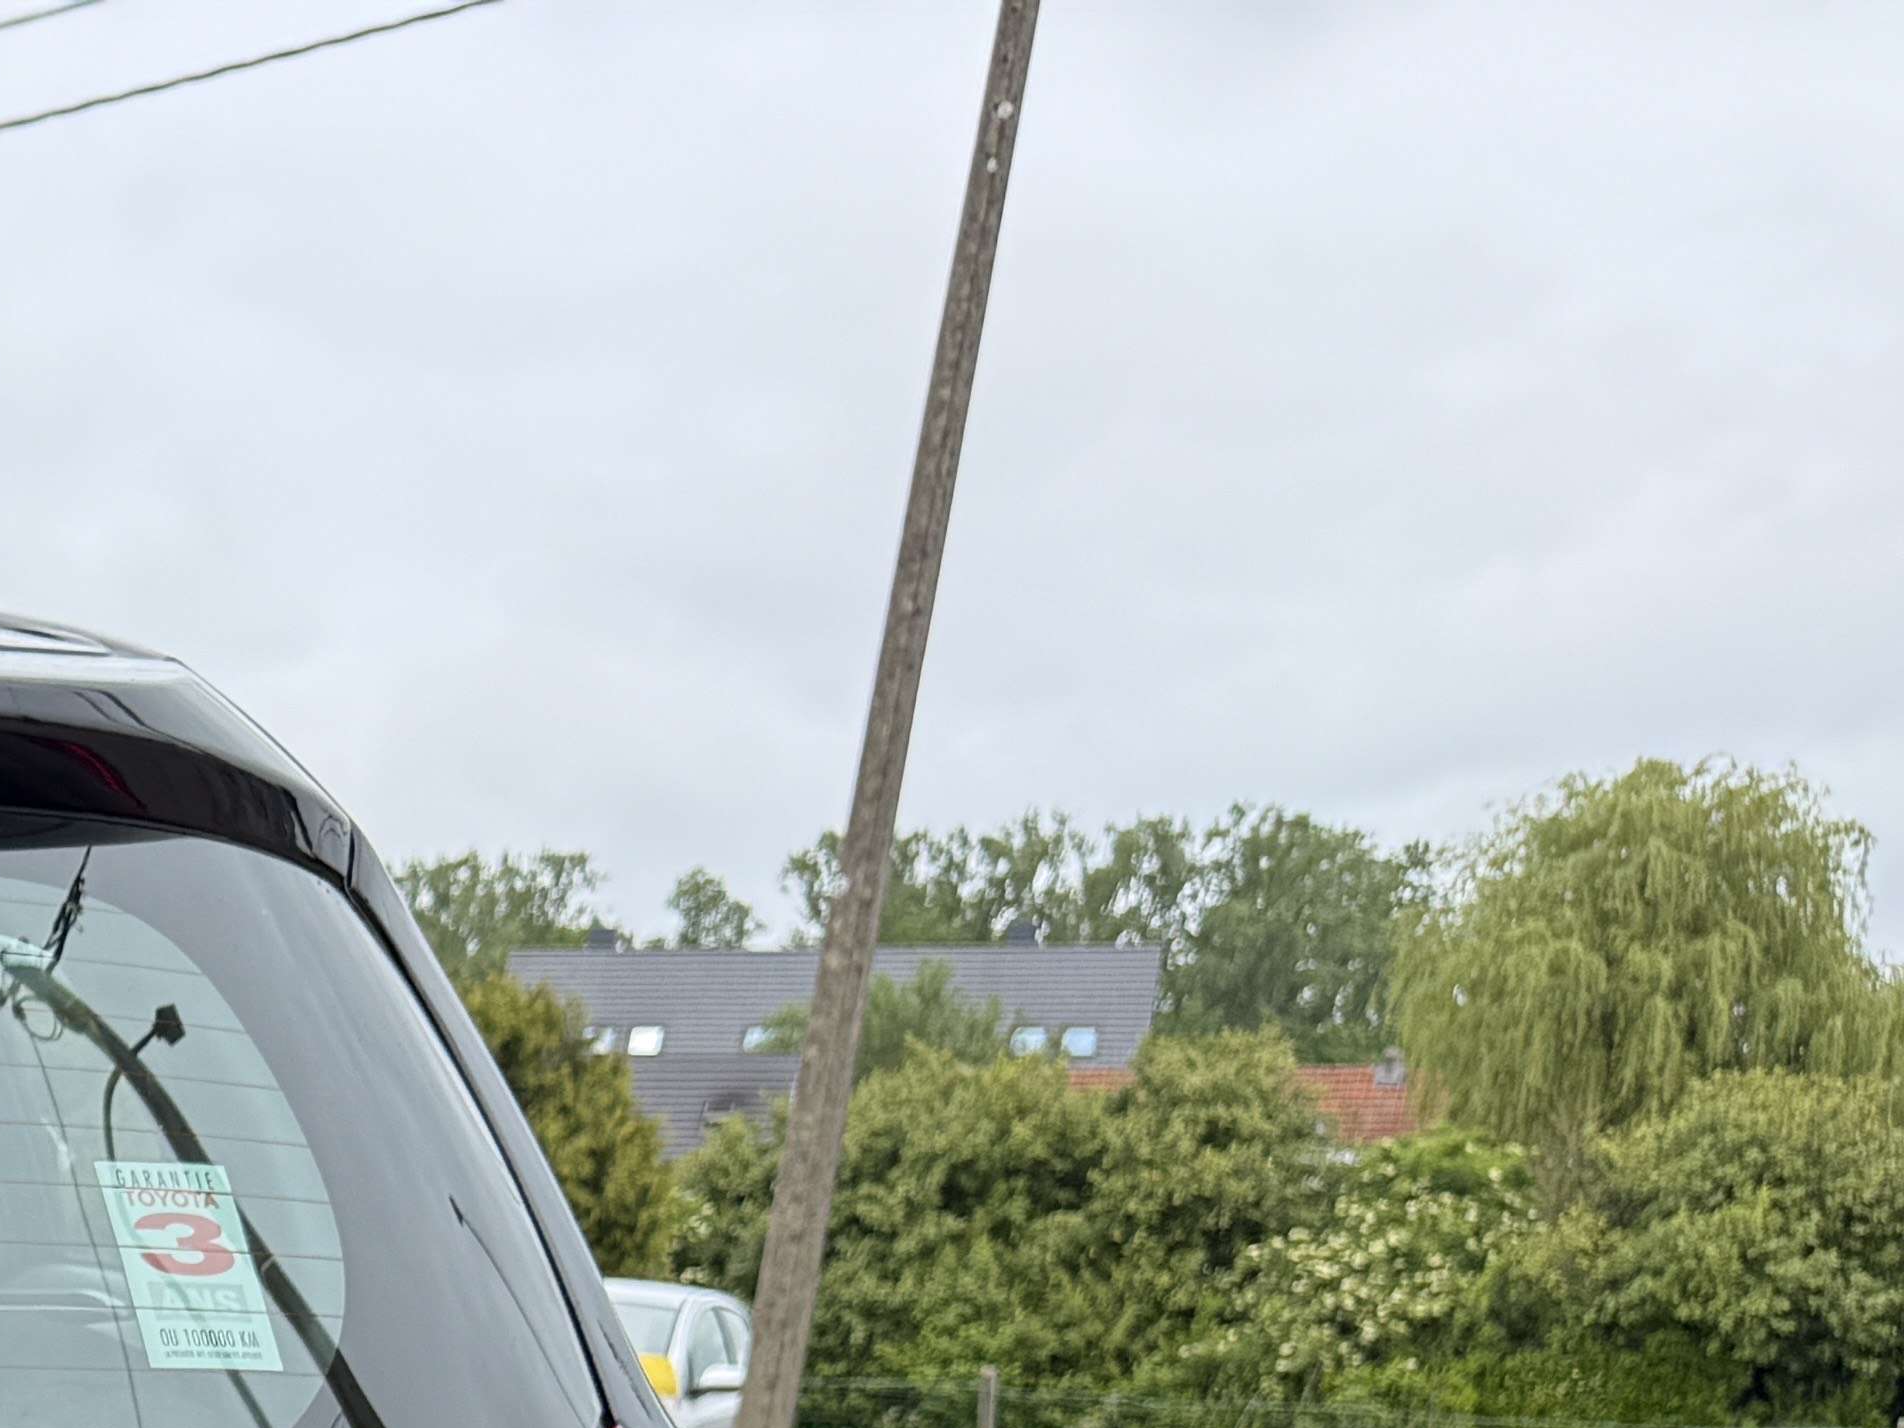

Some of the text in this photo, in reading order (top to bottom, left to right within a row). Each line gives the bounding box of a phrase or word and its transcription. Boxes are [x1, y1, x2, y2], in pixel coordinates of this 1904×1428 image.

[115, 1167, 213, 1191] GARANTIE
[126, 1189, 220, 1210] TOYOTA
[133, 1212, 236, 1277] 3
[160, 1287, 245, 1316] ANS
[160, 1328, 261, 1349] OU 100000 KM
